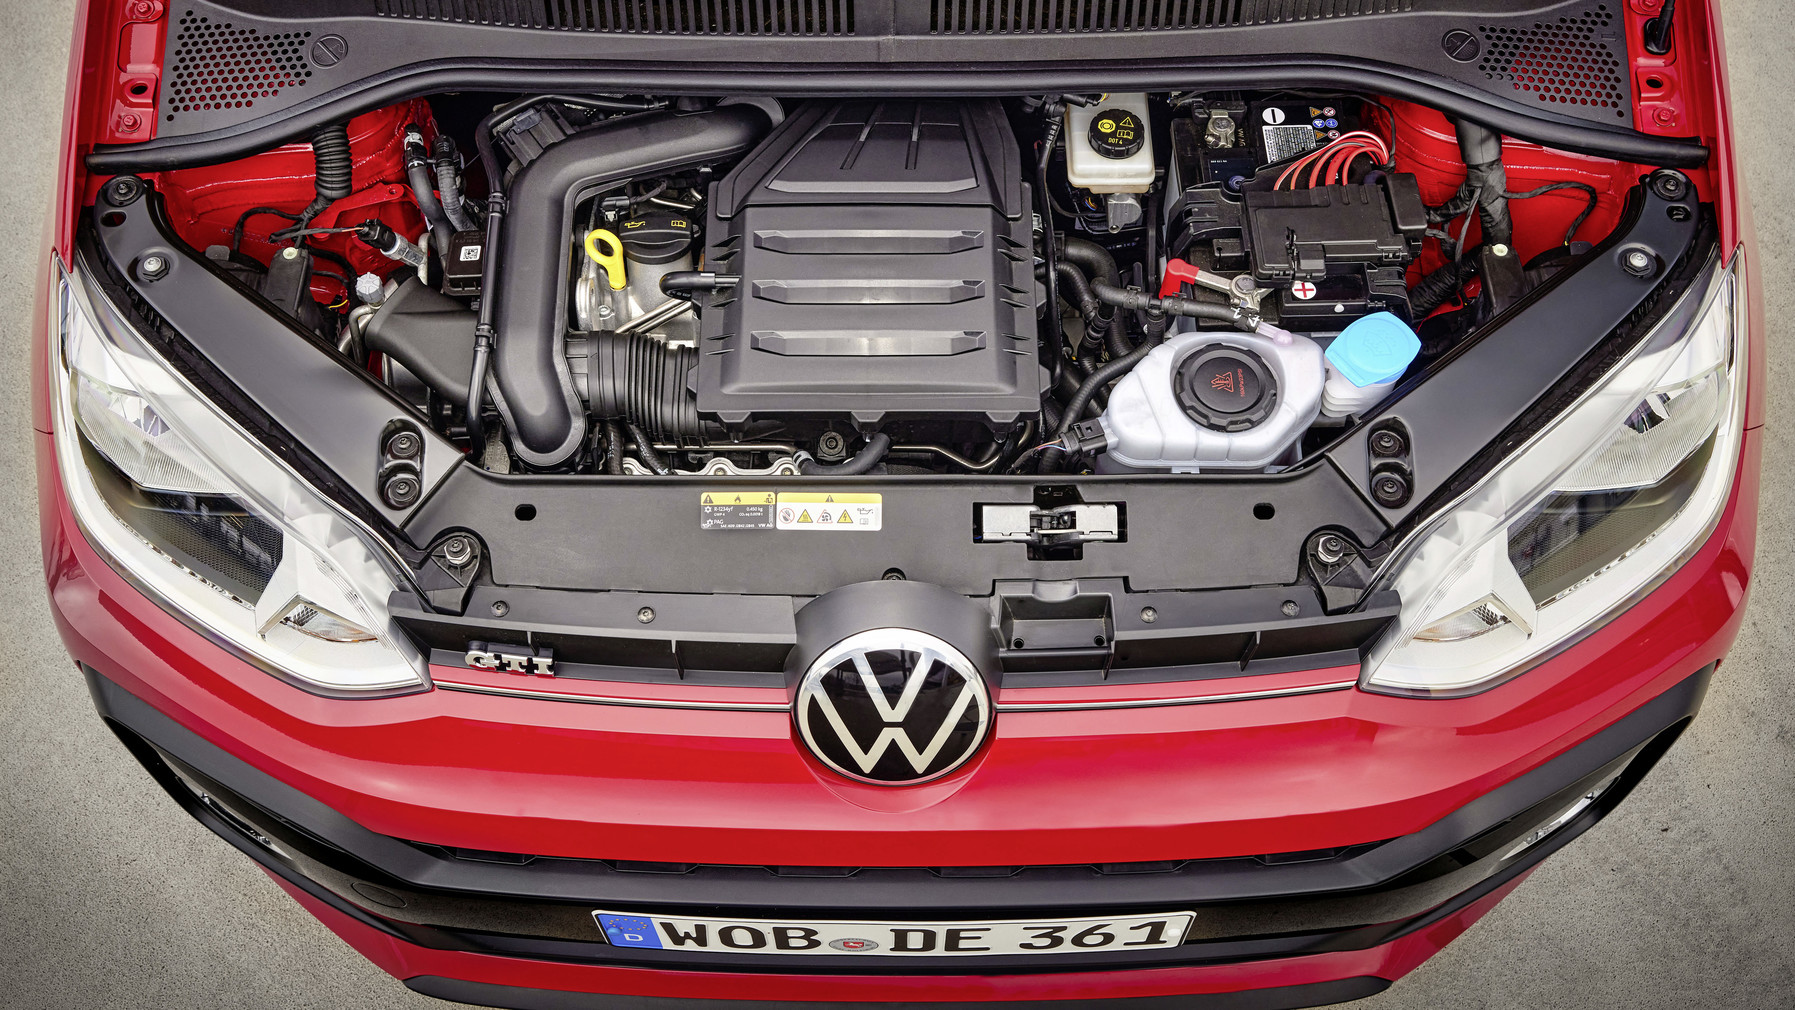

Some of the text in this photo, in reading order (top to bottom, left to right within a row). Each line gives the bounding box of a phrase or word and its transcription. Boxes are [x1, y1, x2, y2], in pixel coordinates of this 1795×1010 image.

[464, 647, 555, 677] GTI
[624, 933, 643, 942] D
[659, 921, 822, 950] WOB
[889, 928, 991, 952] DE
[1019, 920, 1168, 950] 361
